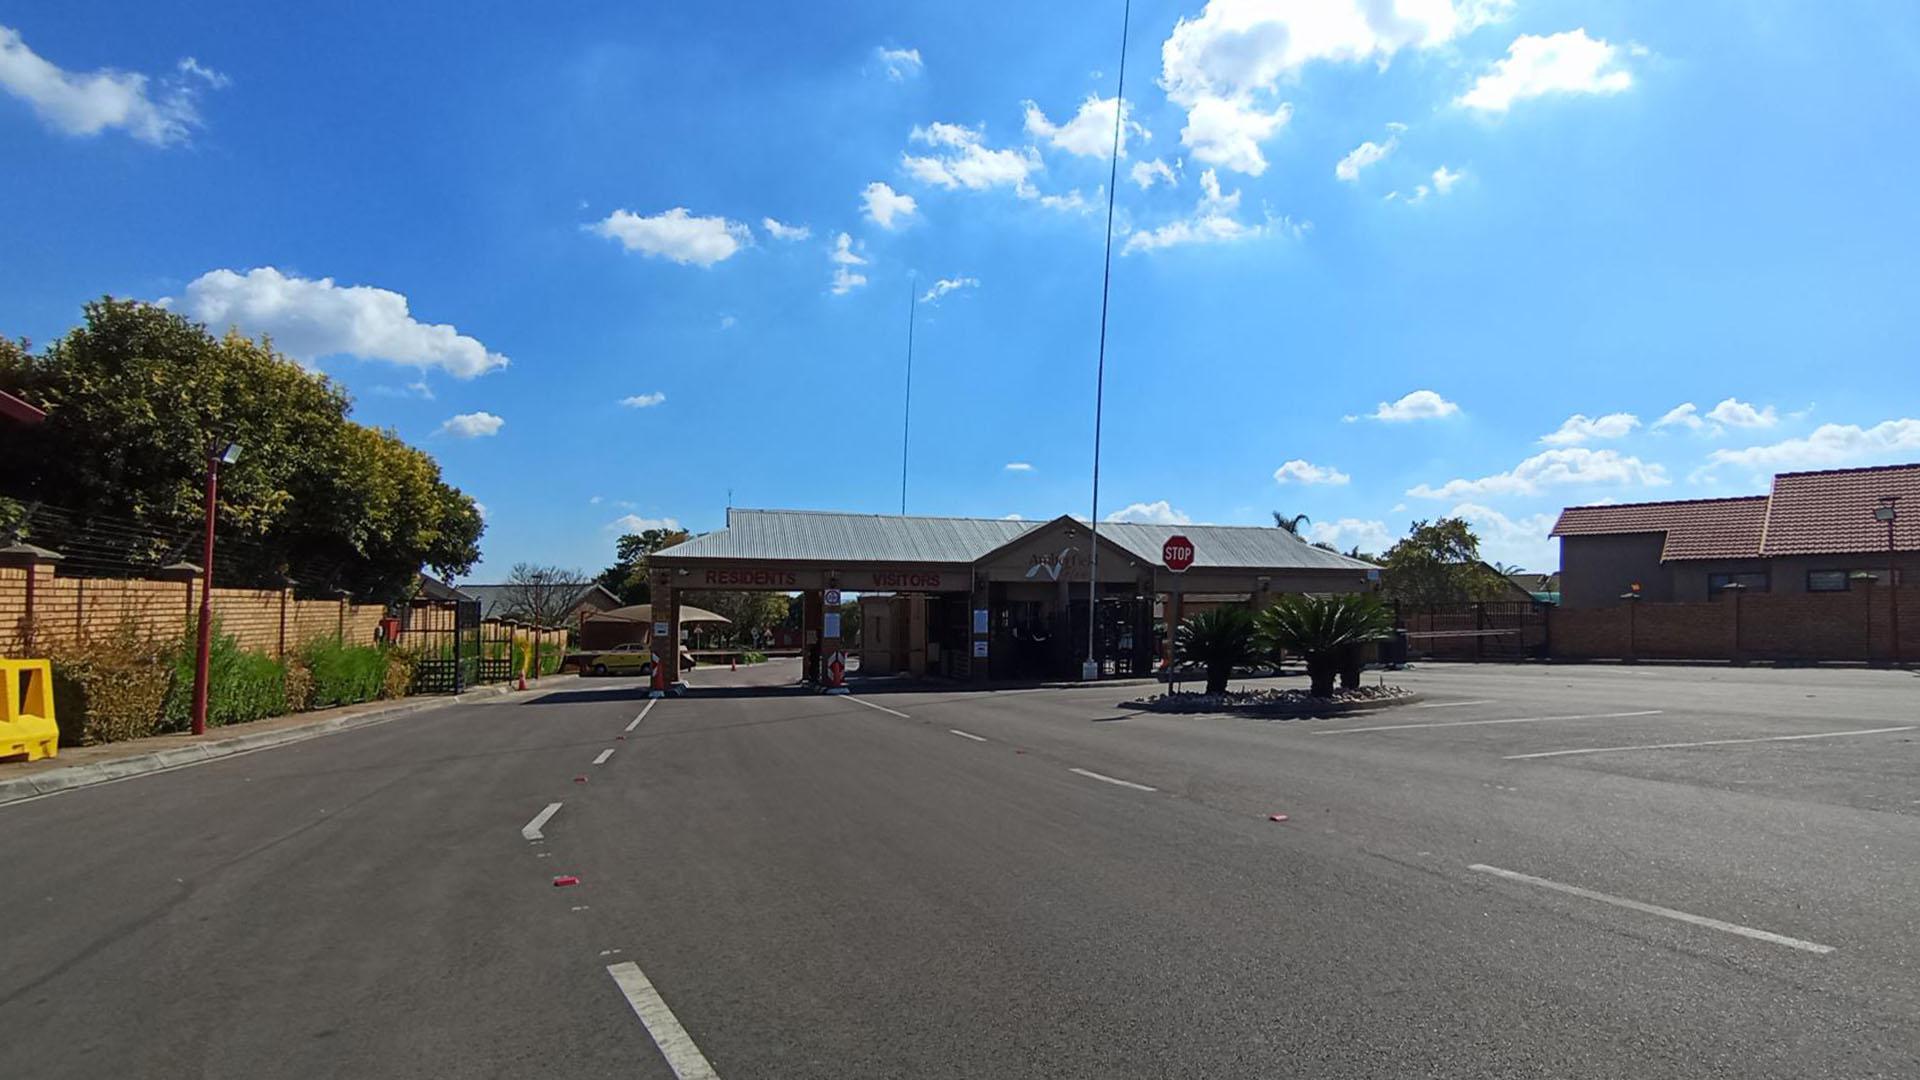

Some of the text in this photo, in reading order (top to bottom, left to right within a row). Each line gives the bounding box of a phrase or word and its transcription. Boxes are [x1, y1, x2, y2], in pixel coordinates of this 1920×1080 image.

[1165, 546, 1192, 561] STOP
[705, 570, 796, 585] RESIDENTS
[873, 573, 941, 587] VISITORS
